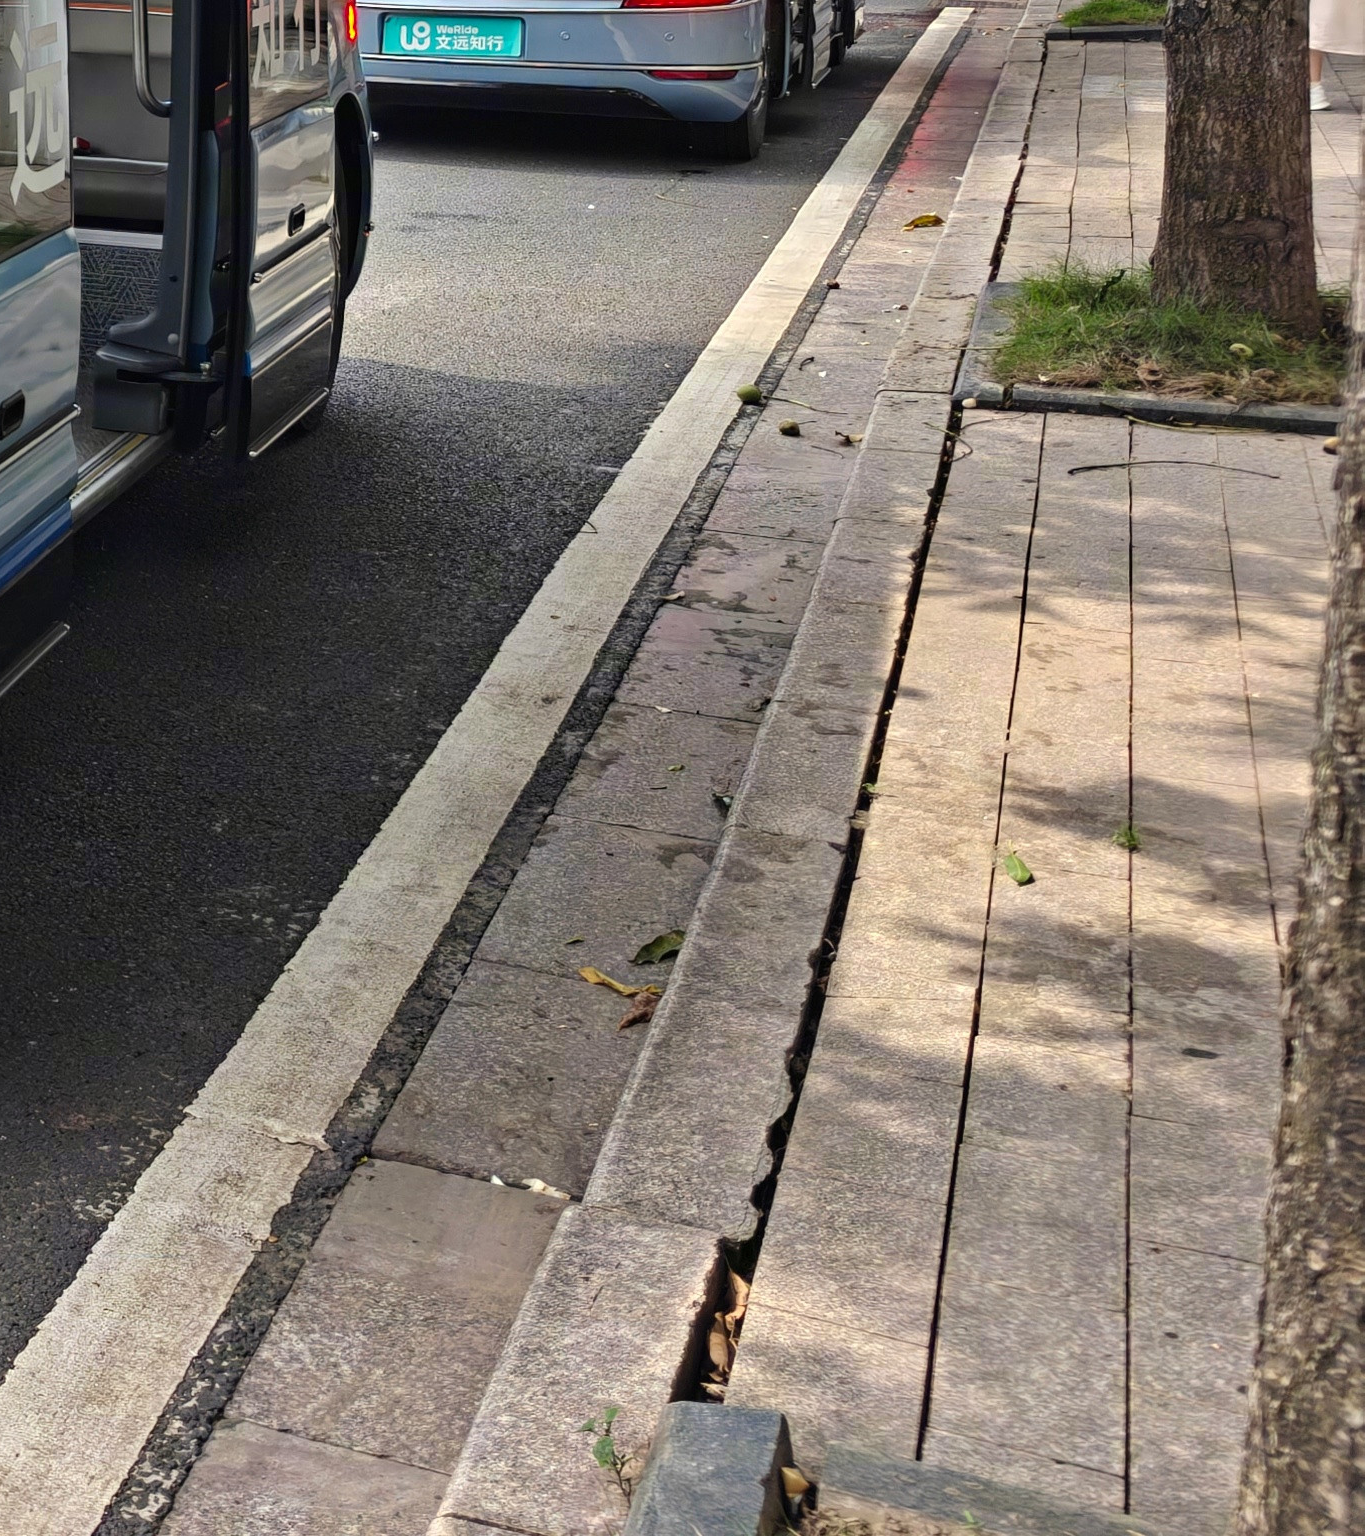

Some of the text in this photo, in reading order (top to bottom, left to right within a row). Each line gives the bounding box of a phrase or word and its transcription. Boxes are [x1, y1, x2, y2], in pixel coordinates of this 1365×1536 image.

[435, 24, 479, 35] WeRide
[434, 35, 504, 52] 文远知行
